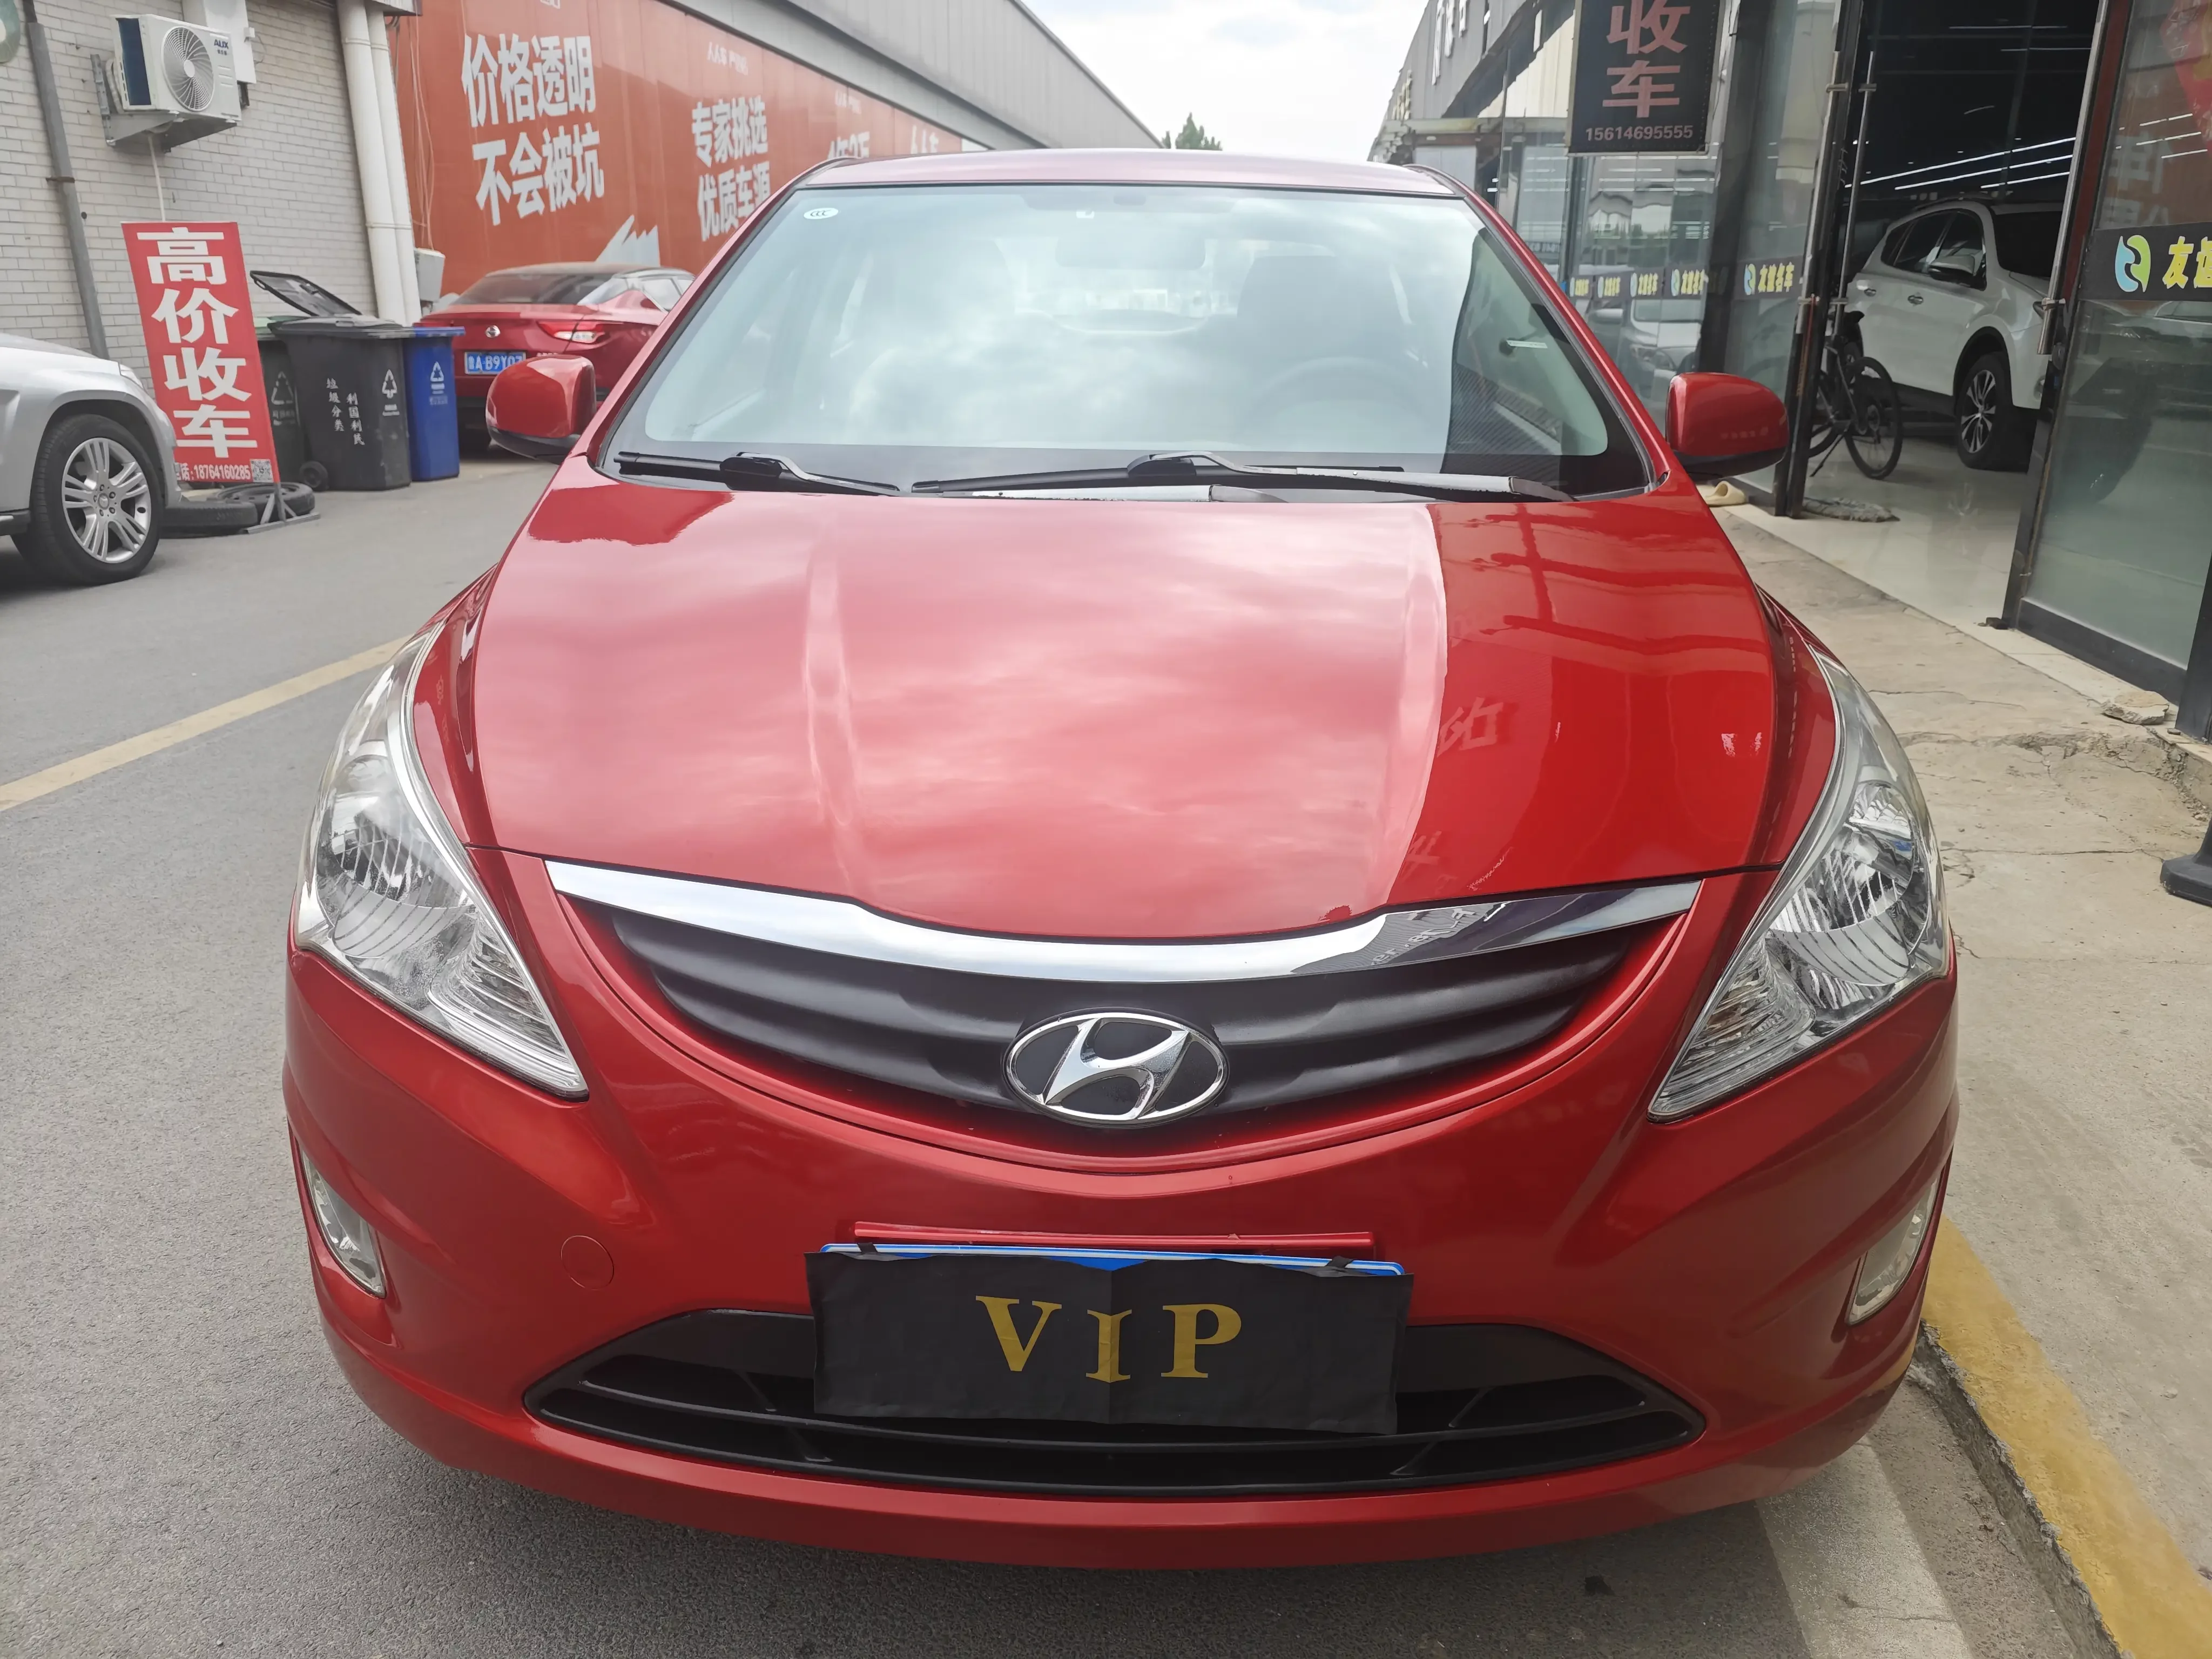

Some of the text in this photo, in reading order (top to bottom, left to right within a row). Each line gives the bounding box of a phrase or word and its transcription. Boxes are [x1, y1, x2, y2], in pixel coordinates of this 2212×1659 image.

[214, 39, 229, 49] AUX
[461, 33, 596, 128] 价格透明
[1602, 0, 1691, 118] 收车
[692, 95, 768, 168] 专家挑选
[1586, 125, 1694, 141] 15614695555
[471, 122, 605, 226] 不会被坑
[697, 161, 771, 242] 优质车源
[137, 227, 258, 458] 高价收车
[346, 392, 365, 446] 利国利民
[975, 1295, 1242, 1383] VIP
